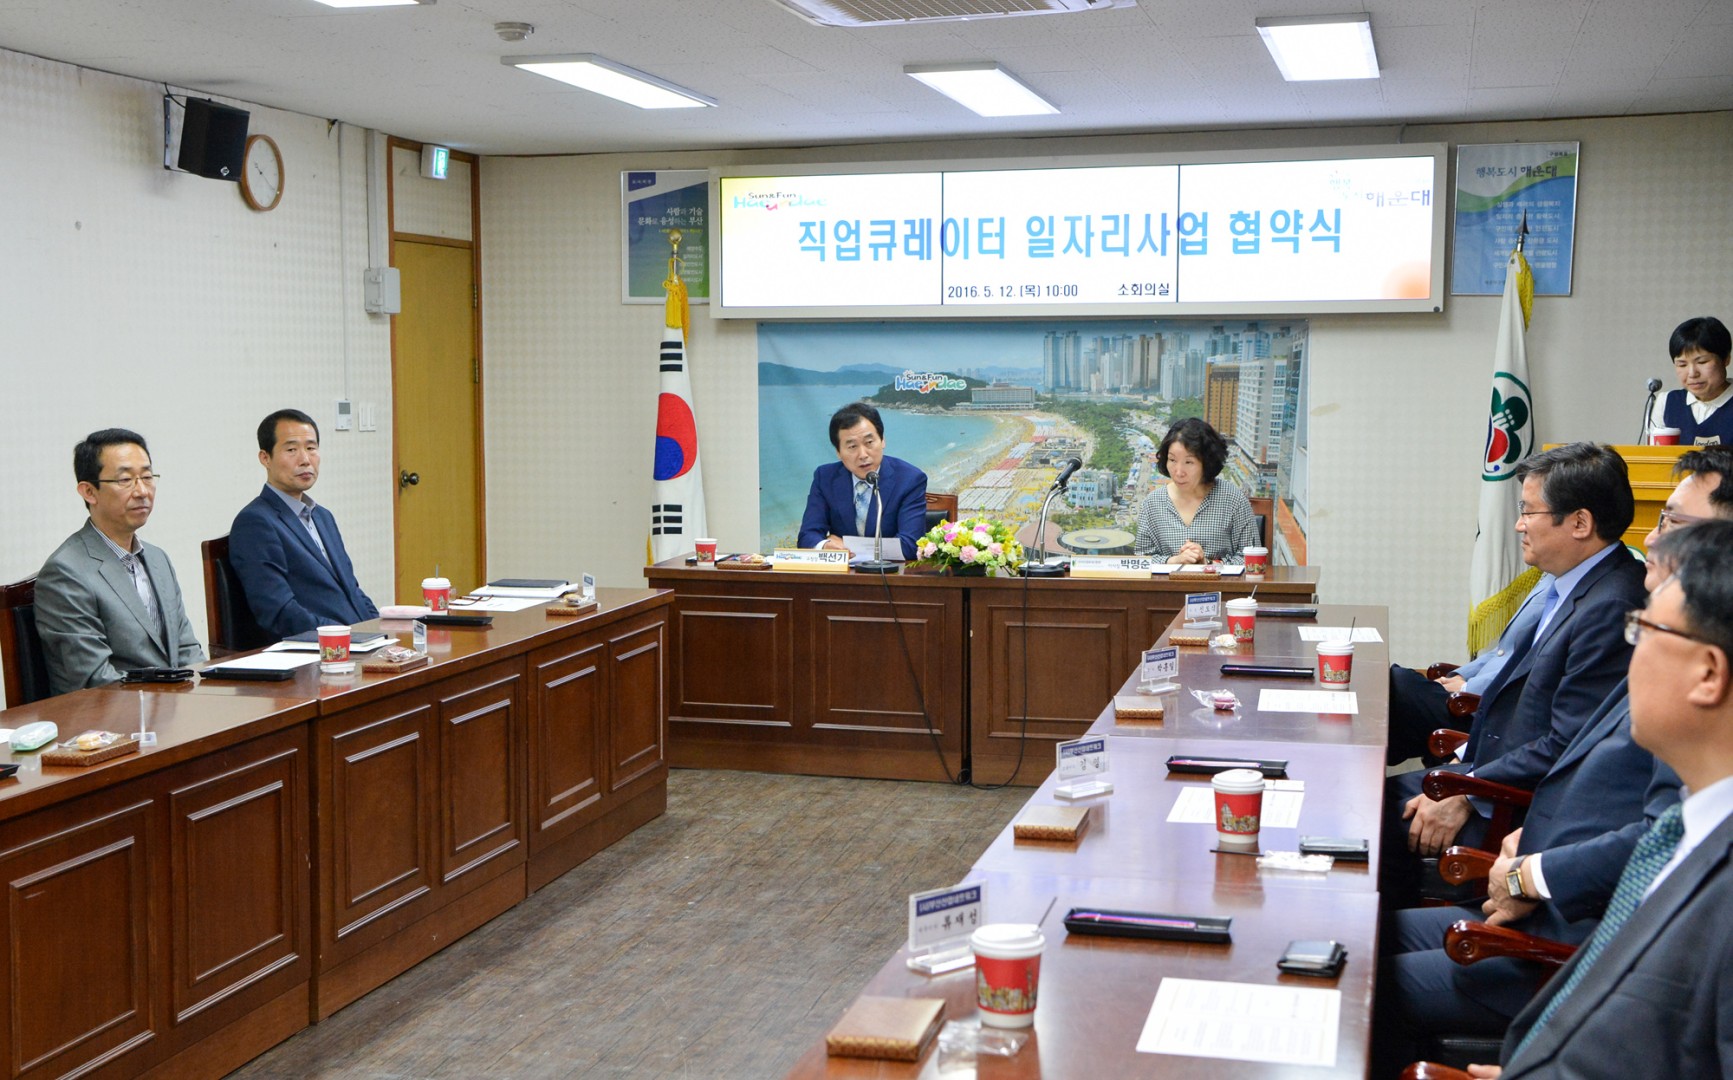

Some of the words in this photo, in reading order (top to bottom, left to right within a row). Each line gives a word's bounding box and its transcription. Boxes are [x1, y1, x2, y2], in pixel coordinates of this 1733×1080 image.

[797, 217, 1007, 263] 직업큐레이터
[1026, 211, 1209, 258] 일자리사업
[1229, 208, 1342, 255] 협약식
[947, 285, 980, 298] 2016.
[983, 285, 994, 298] 5.
[999, 285, 1017, 298] 12.
[1046, 284, 1078, 297] 10:00
[1117, 282, 1170, 296] 소회의실
[818, 552, 847, 563] 백선기
[1120, 559, 1150, 570] 박명순
